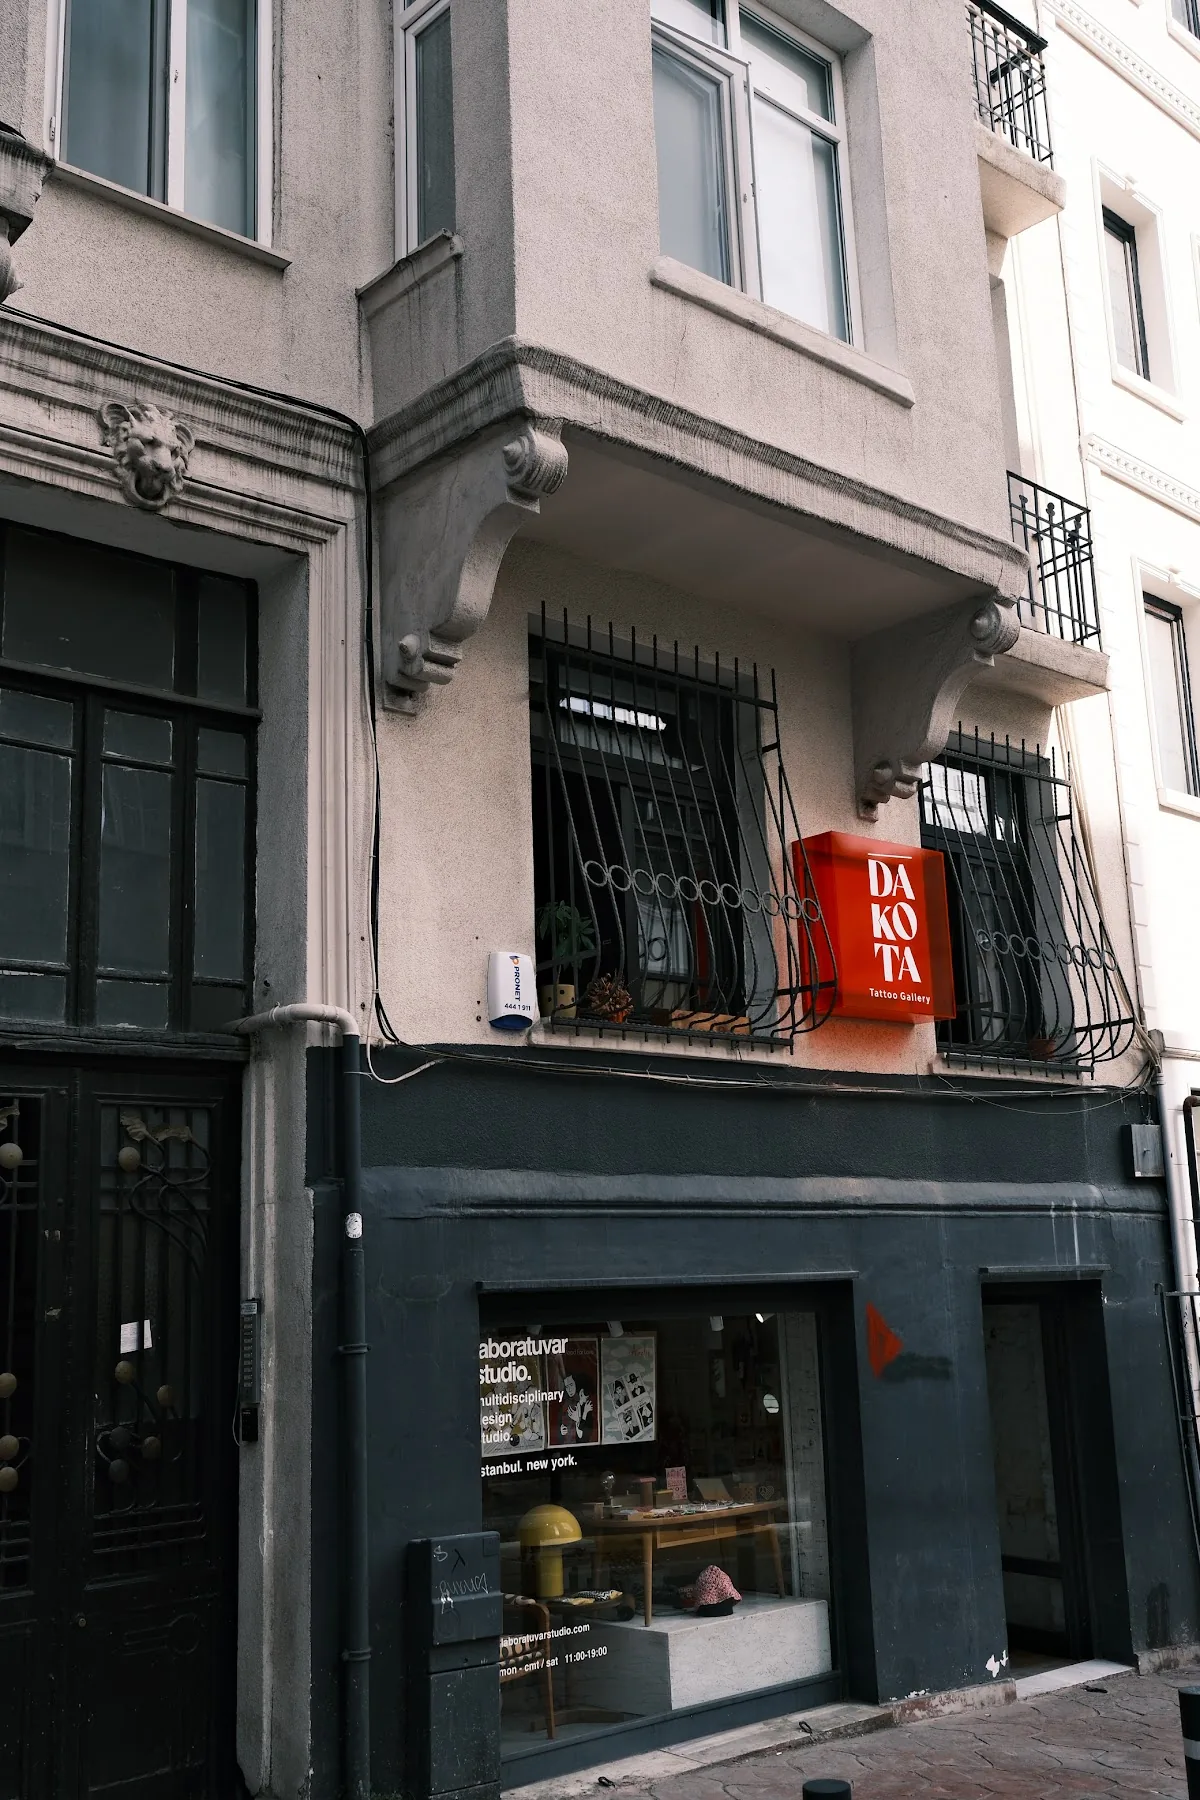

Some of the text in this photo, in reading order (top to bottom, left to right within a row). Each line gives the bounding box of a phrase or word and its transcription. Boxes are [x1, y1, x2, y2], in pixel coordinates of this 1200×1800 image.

[867, 858, 916, 901] DA
[870, 901, 918, 941] KO
[873, 942, 922, 983] TA
[513, 966, 521, 1002] PRONET
[869, 987, 931, 1005] Tattoo Gallery
[479, 1361, 532, 1385] studio.
[526, 1458, 549, 1471] new
[551, 1453, 578, 1471] york.
[499, 1666, 517, 1677] mon
[524, 1661, 540, 1673] cmt
[545, 1657, 559, 1668] sat
[564, 1645, 608, 1664] 11:00-19:00
